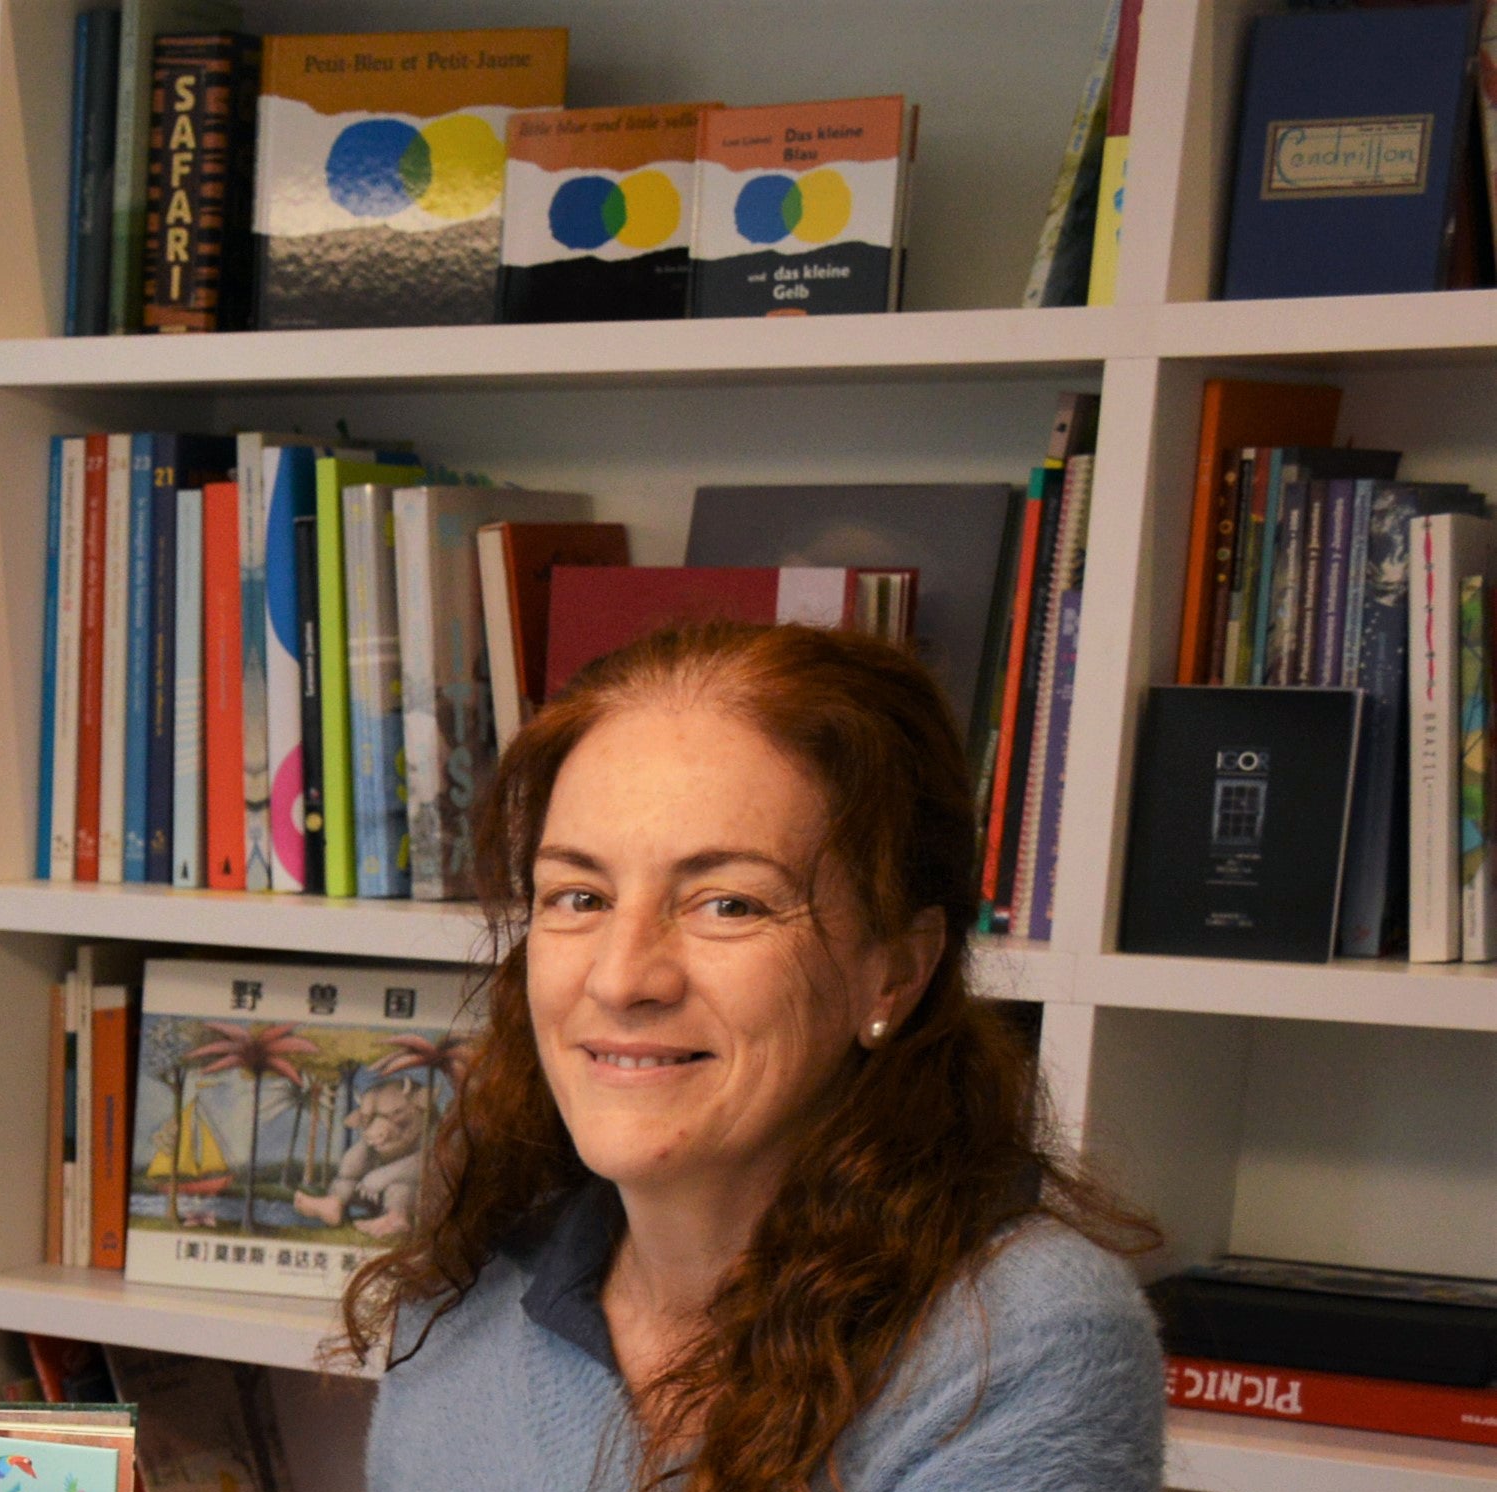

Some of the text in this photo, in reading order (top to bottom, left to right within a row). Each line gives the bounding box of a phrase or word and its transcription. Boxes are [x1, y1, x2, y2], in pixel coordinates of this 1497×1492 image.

[304, 48, 531, 74] Petit-Bleu et Petit-Jaune
[784, 125, 864, 143] Das kleine
[783, 147, 818, 162] Blau
[1276, 127, 1416, 185] Cendrillon
[165, 74, 196, 300] SAFARI
[773, 265, 799, 281] das
[803, 263, 851, 279] kleine
[772, 284, 810, 300] Gelb
[155, 467, 174, 486] 21
[1422, 712, 1438, 785] BRAZIL
[1216, 750, 1270, 773] IGOR
[231, 979, 417, 1019] 野兽国
[1184, 1368, 1303, 1415] PICNIC
